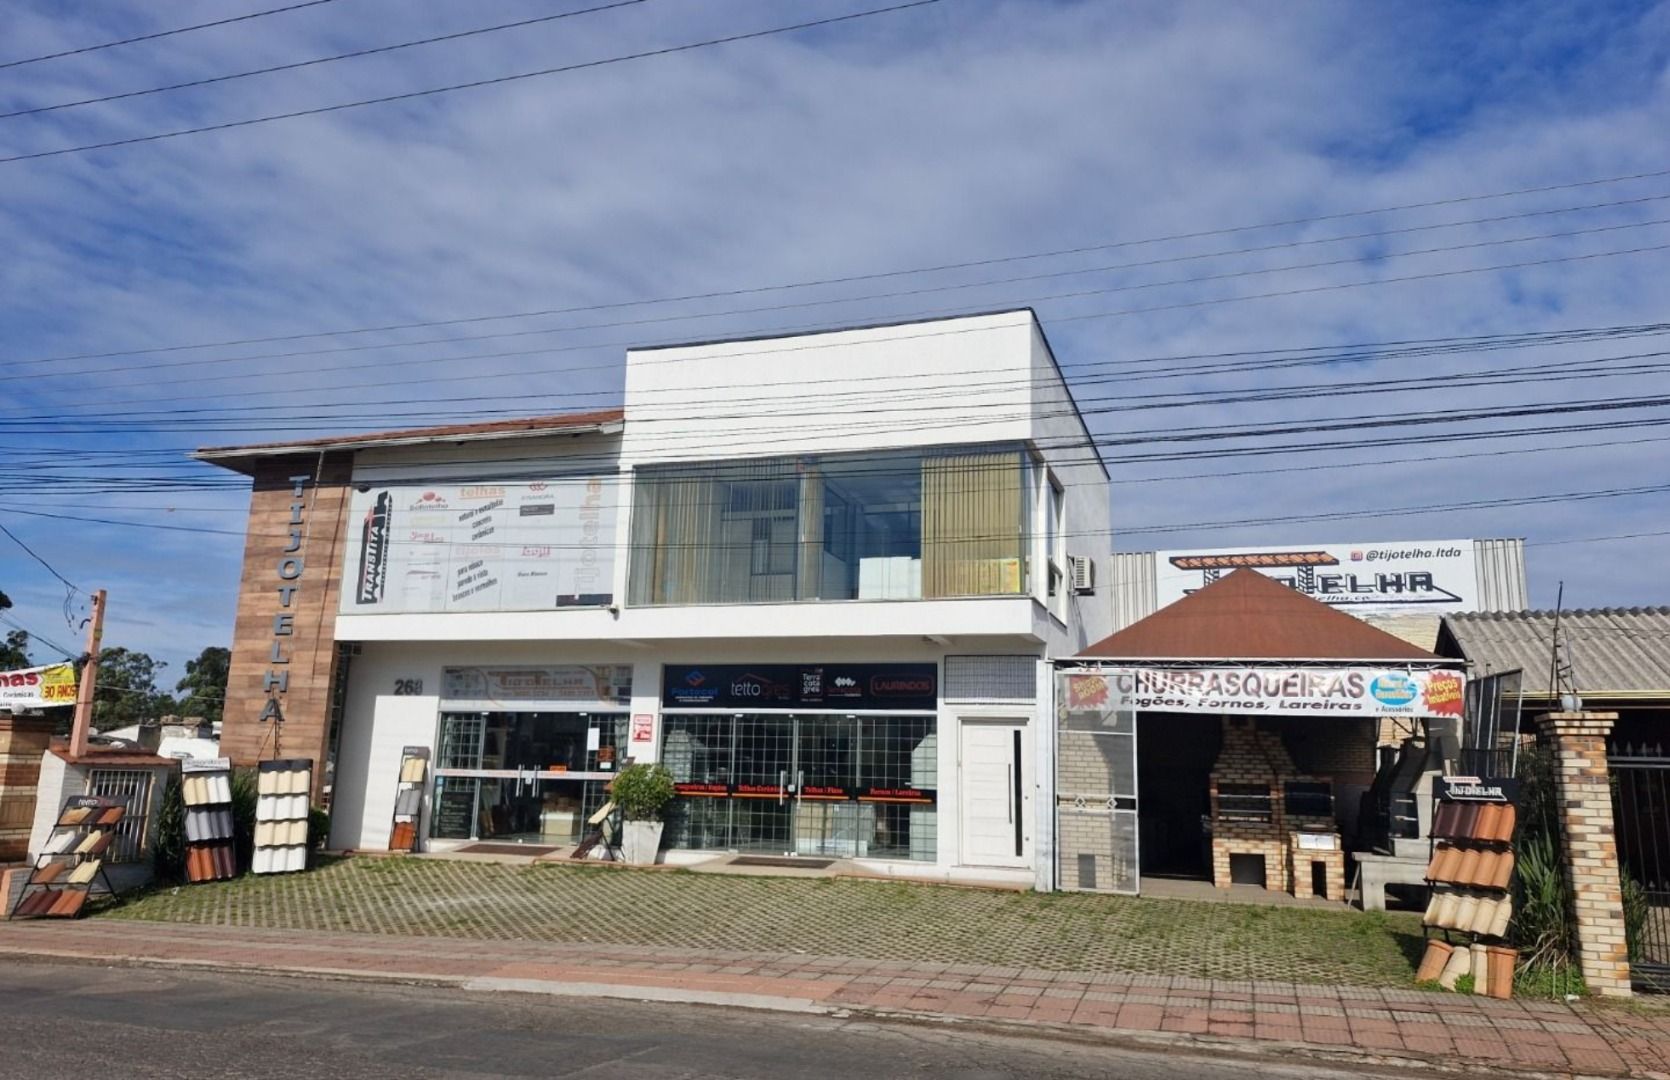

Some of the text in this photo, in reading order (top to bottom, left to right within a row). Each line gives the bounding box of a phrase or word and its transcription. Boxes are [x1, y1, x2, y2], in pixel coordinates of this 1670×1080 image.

[1366, 548, 1462, 561] @tijotelha.ltda
[260, 475, 310, 722] TIJOTELHA
[44, 686, 55, 698] 30
[394, 678, 423, 696] 268
[1116, 670, 1365, 699] CHURRASQUEIRAS
[1278, 700, 1363, 711] Lareiras
